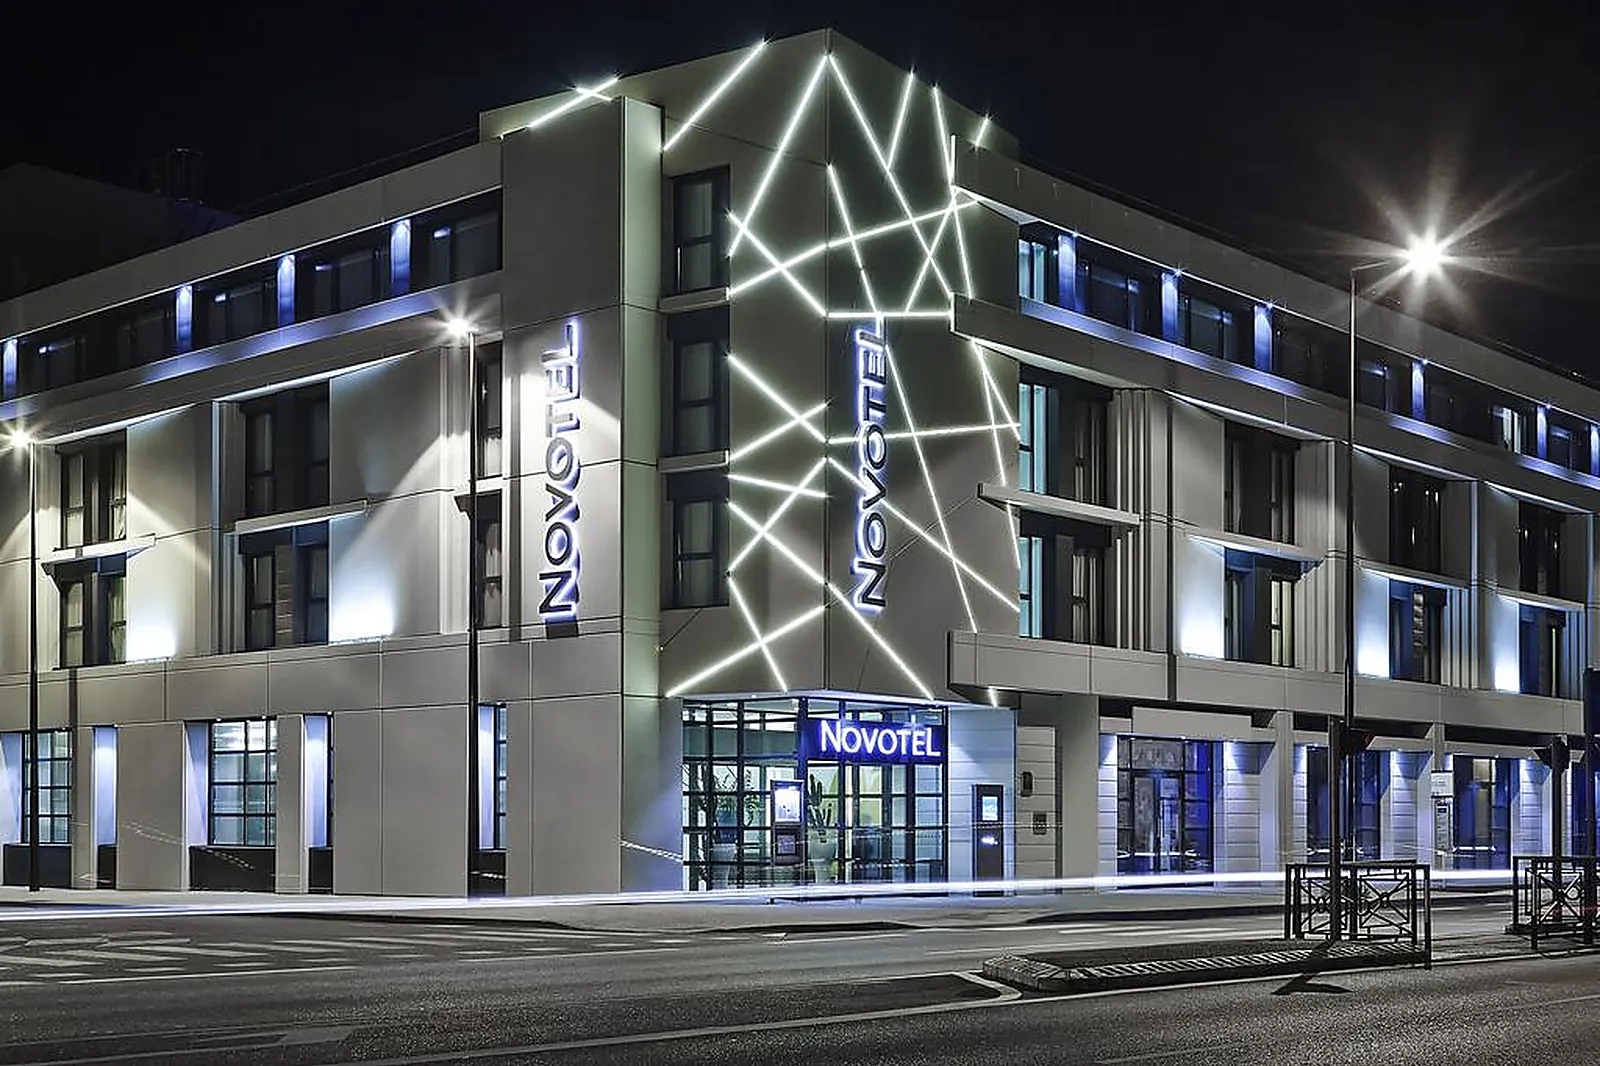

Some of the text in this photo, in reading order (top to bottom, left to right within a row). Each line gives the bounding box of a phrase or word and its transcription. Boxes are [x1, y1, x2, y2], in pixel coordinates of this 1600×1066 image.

[538, 321, 579, 614] NOVOTEL
[856, 314, 887, 608] NOVOTEL
[821, 719, 941, 756] NOVOTEL
